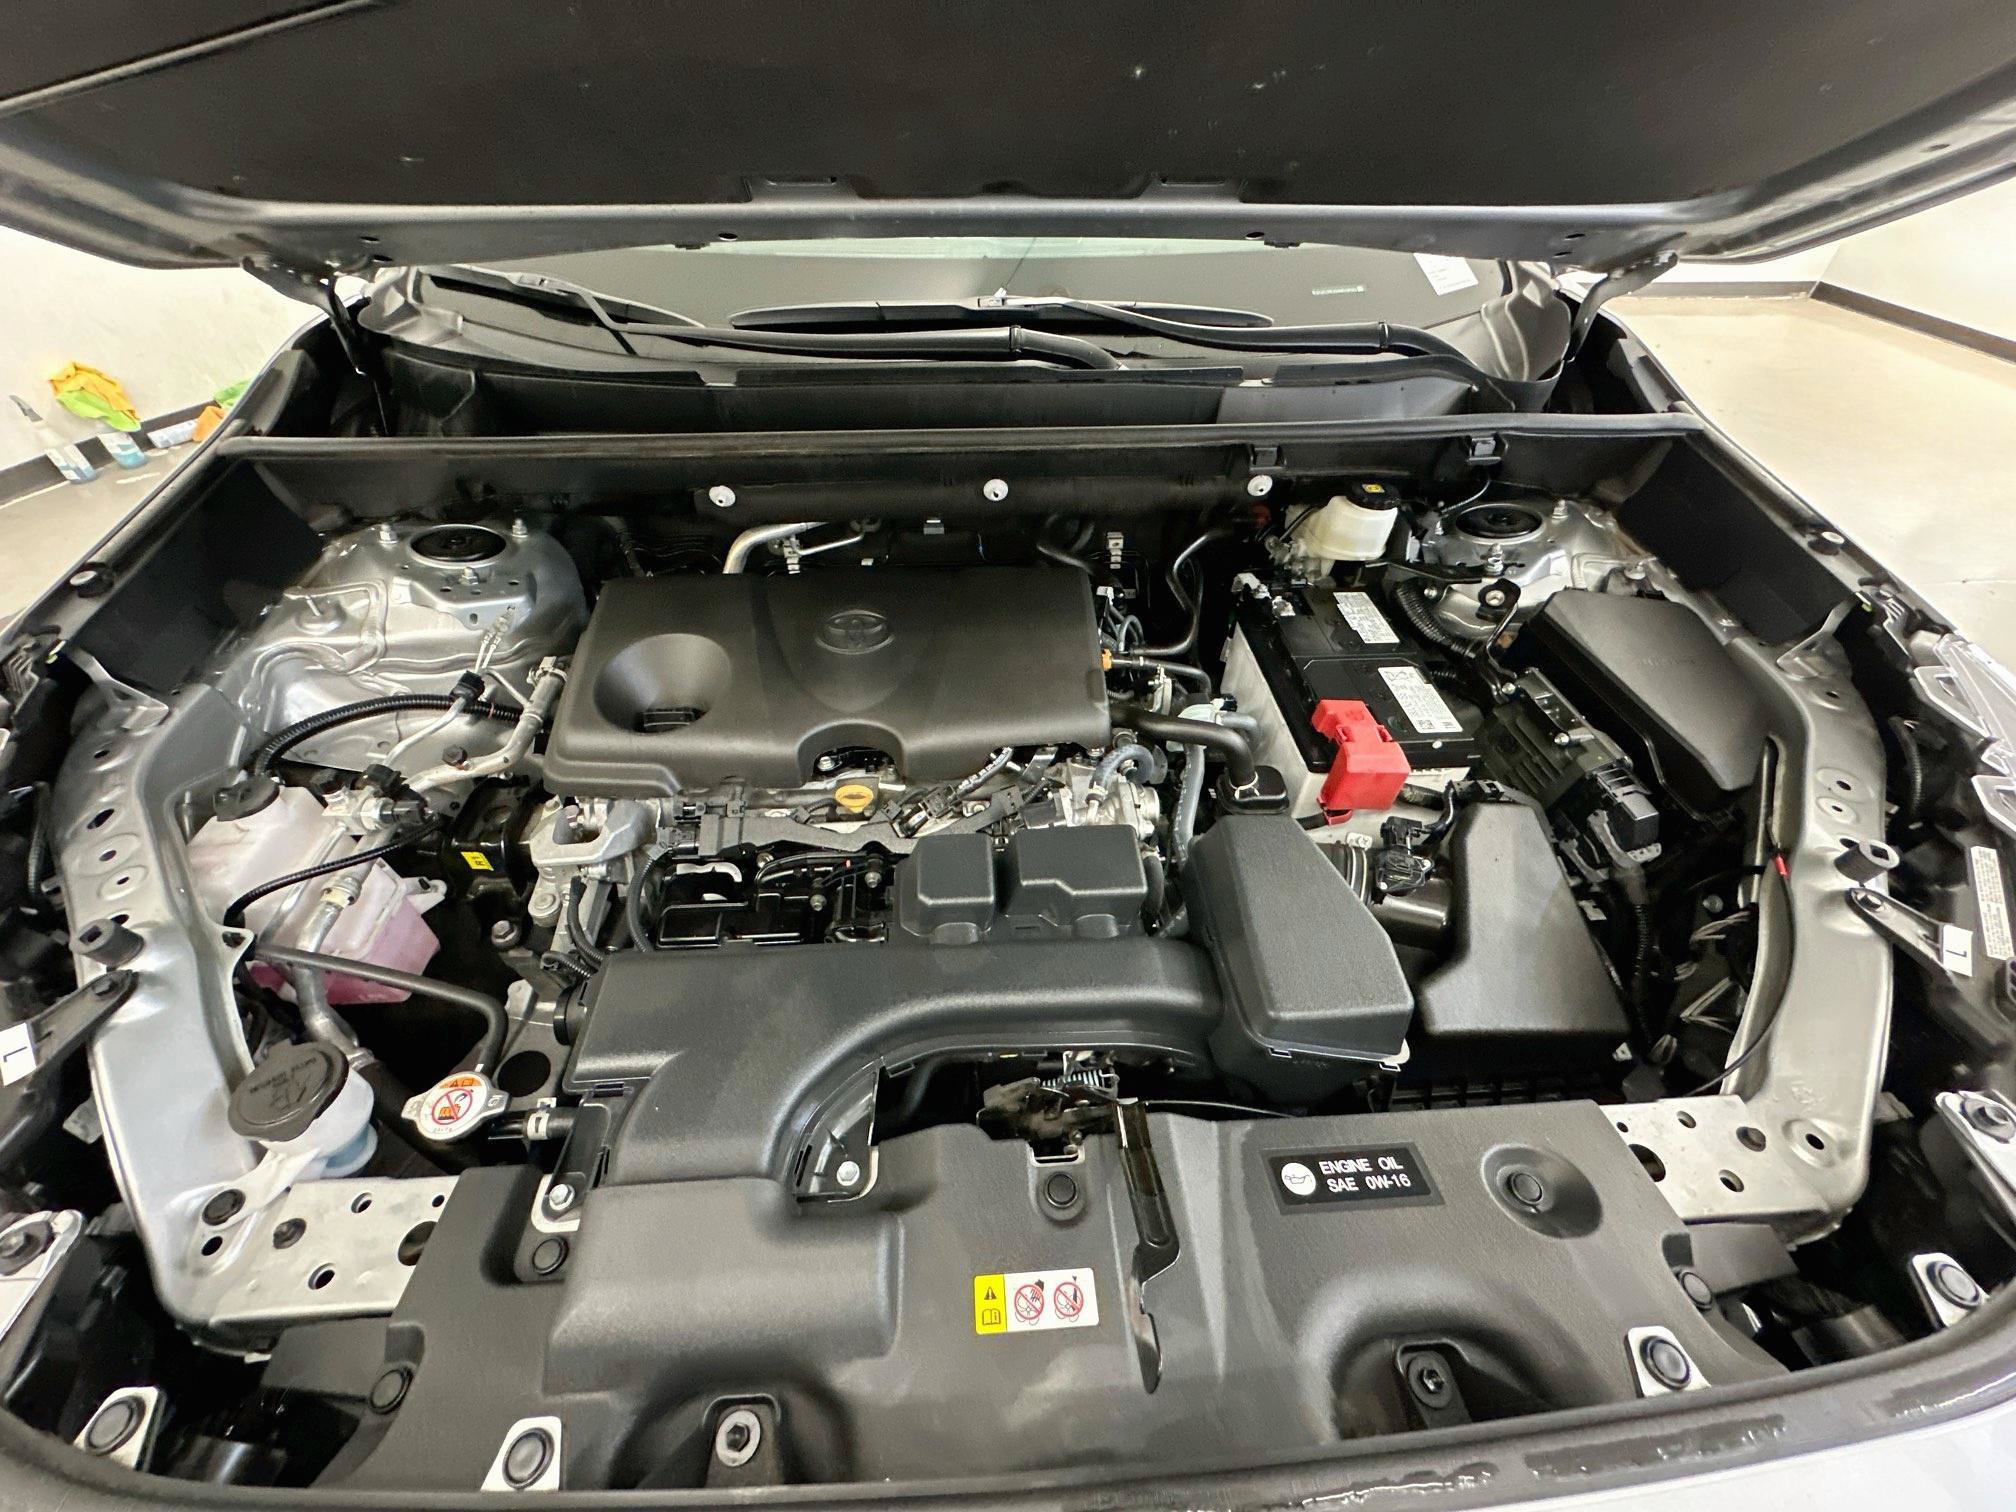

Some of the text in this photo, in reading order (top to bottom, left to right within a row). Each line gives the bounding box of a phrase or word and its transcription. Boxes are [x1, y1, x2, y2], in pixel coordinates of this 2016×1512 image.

[1318, 1156, 1404, 1175] ENGINE OIL
[1326, 1173, 1411, 1193] SAE 0W-16
